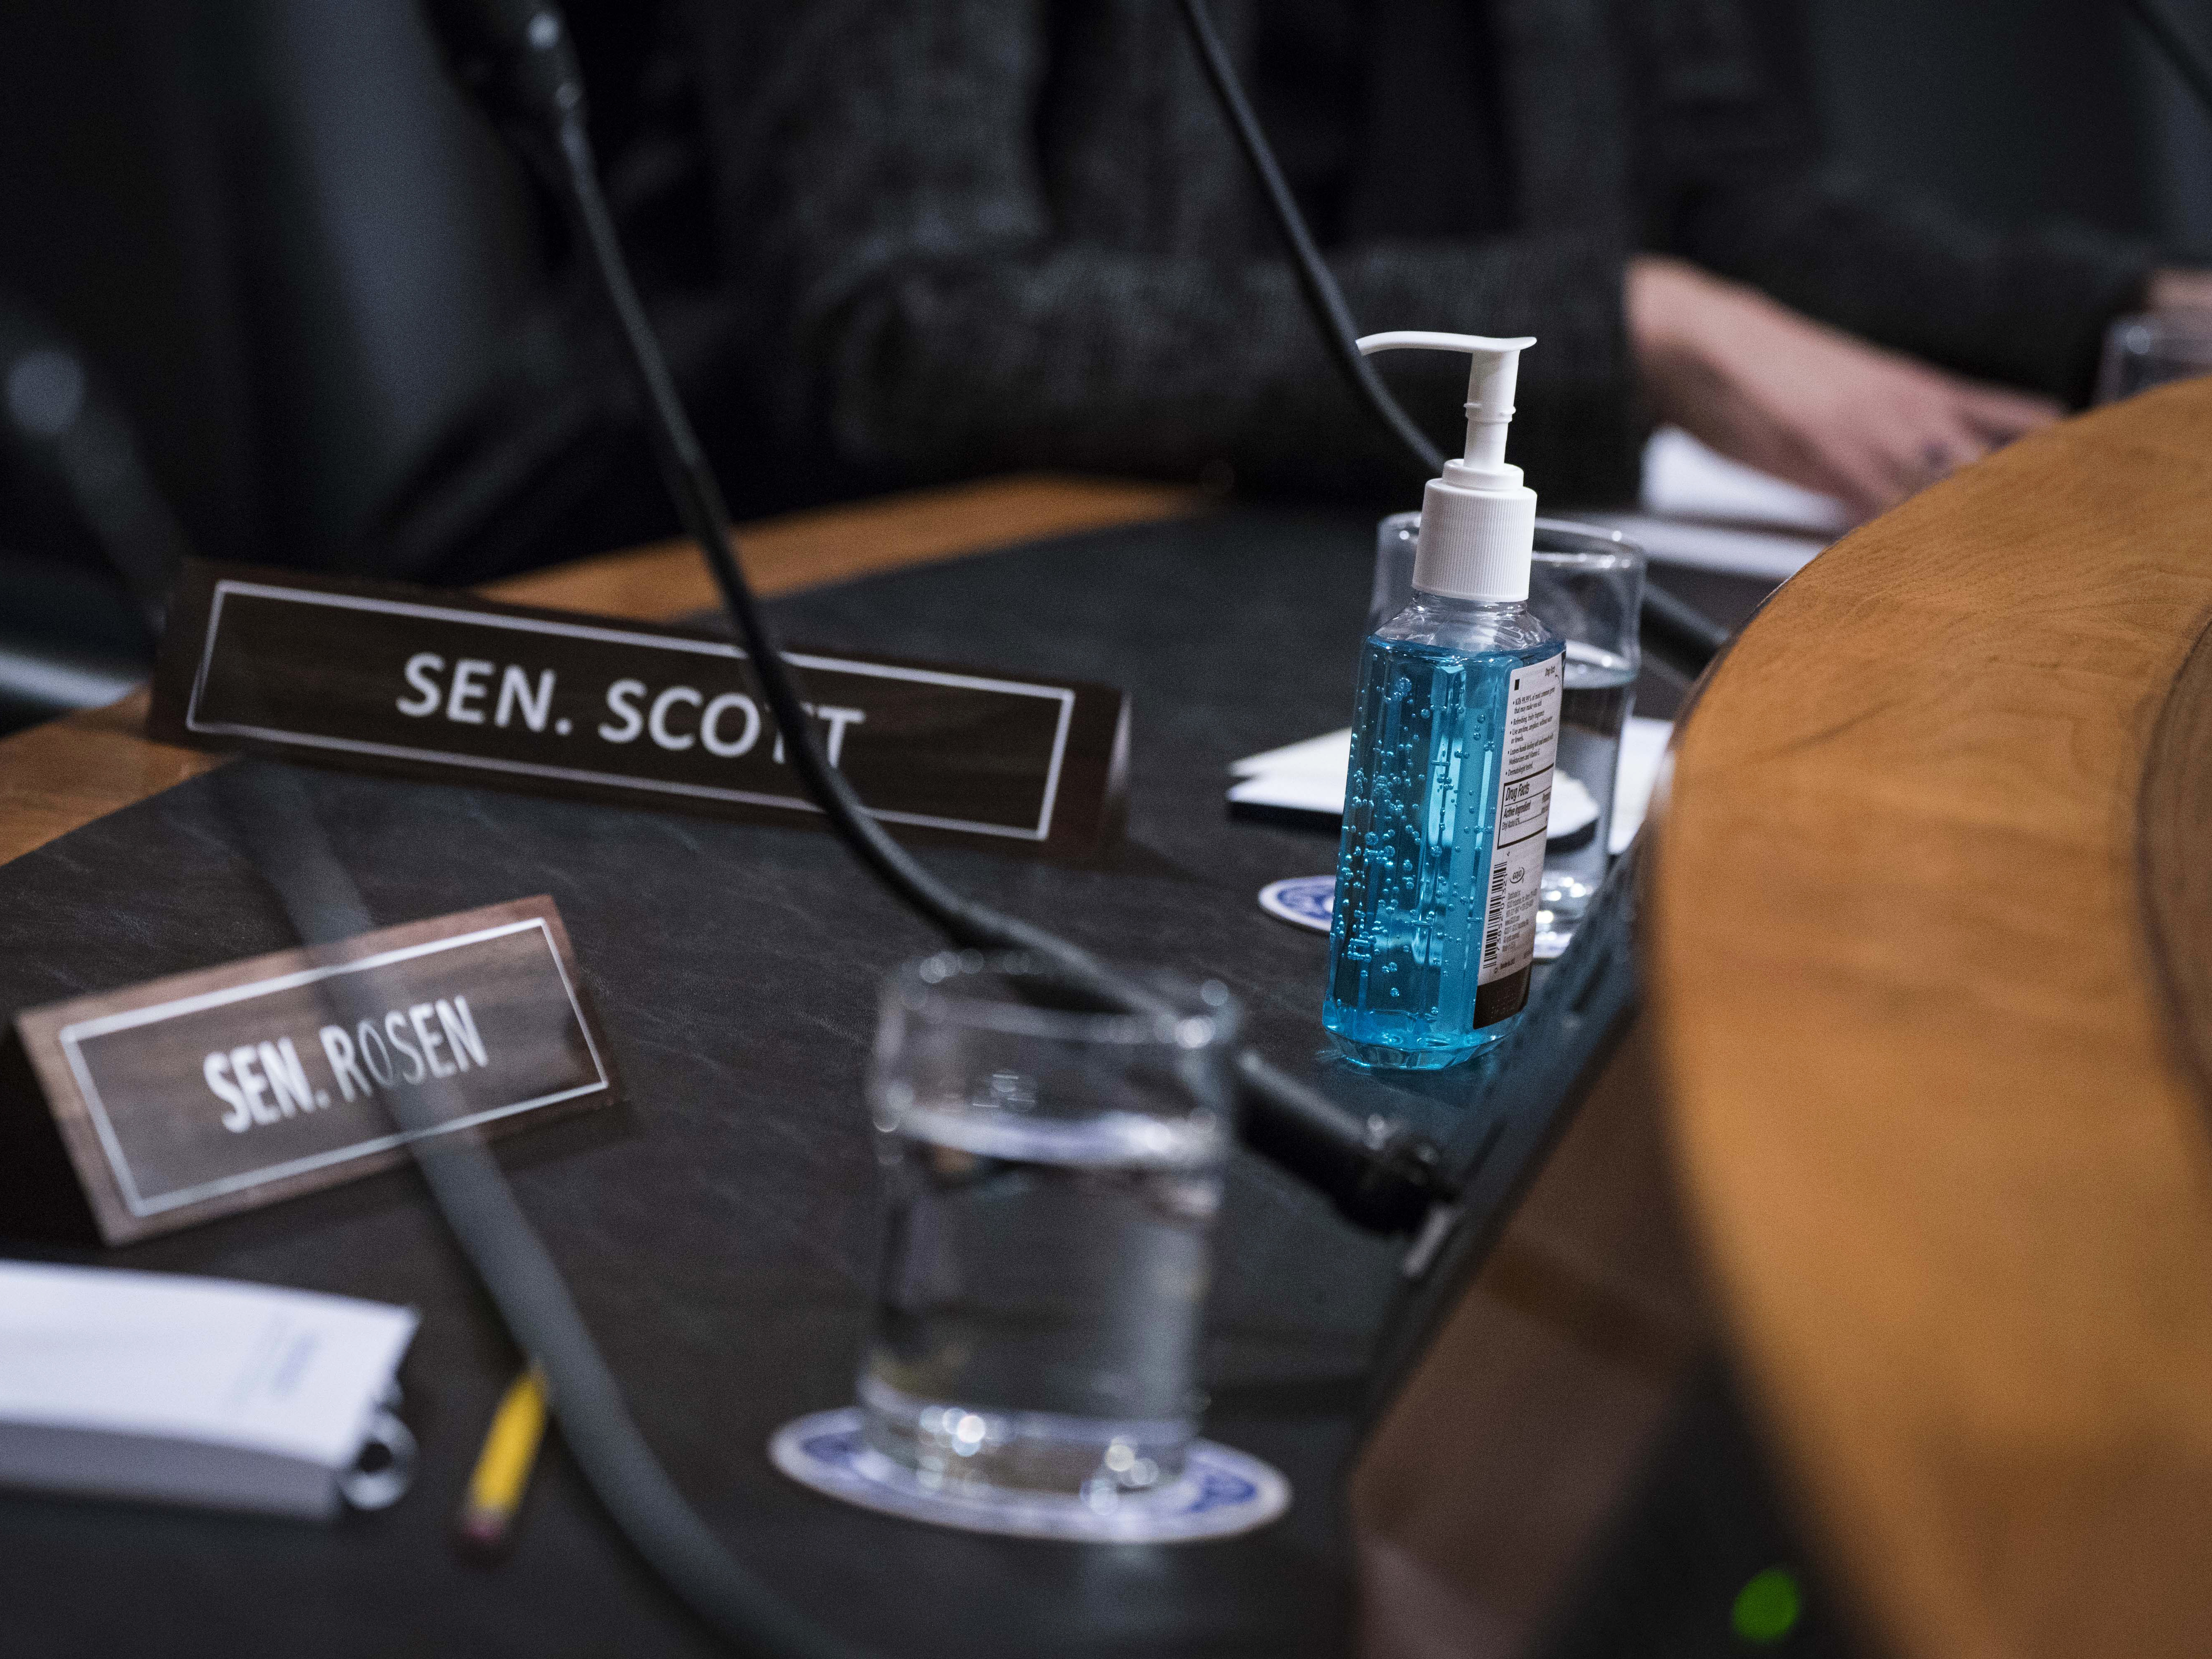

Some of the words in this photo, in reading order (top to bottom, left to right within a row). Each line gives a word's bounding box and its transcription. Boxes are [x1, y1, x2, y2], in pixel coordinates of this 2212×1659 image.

[396, 652, 573, 737] SEN.
[1504, 808, 1515, 818] Active
[1515, 801, 1531, 816] ingredient
[1506, 788, 1517, 801] Drug
[1518, 782, 1529, 796] Facts
[203, 1037, 331, 1133] SEN.
[319, 996, 488, 1103] ROSEN
